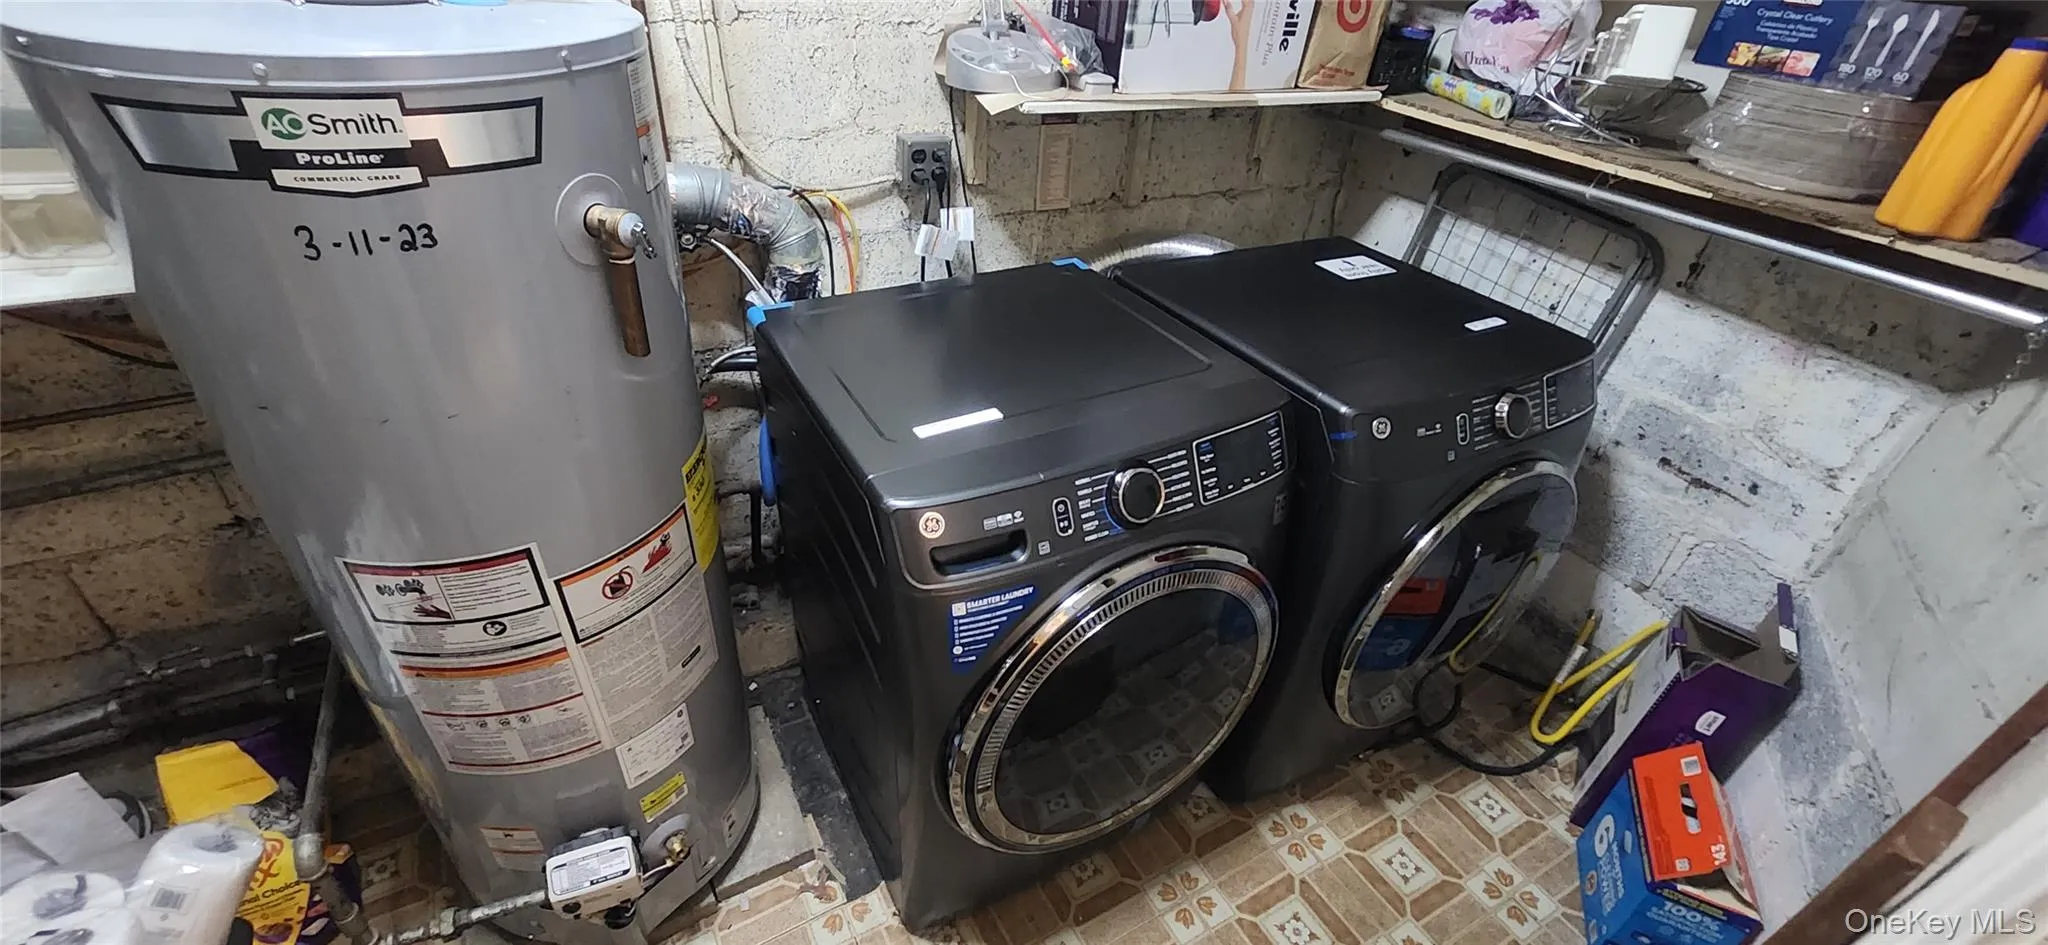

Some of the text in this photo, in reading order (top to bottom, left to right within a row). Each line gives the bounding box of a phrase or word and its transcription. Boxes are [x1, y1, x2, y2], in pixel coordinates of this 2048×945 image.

[1892, 71, 1909, 82] 60
[295, 151, 384, 166] ProLine
[294, 173, 402, 183] COMMERCIAL GRADE
[1663, 900, 1720, 932] 100%
